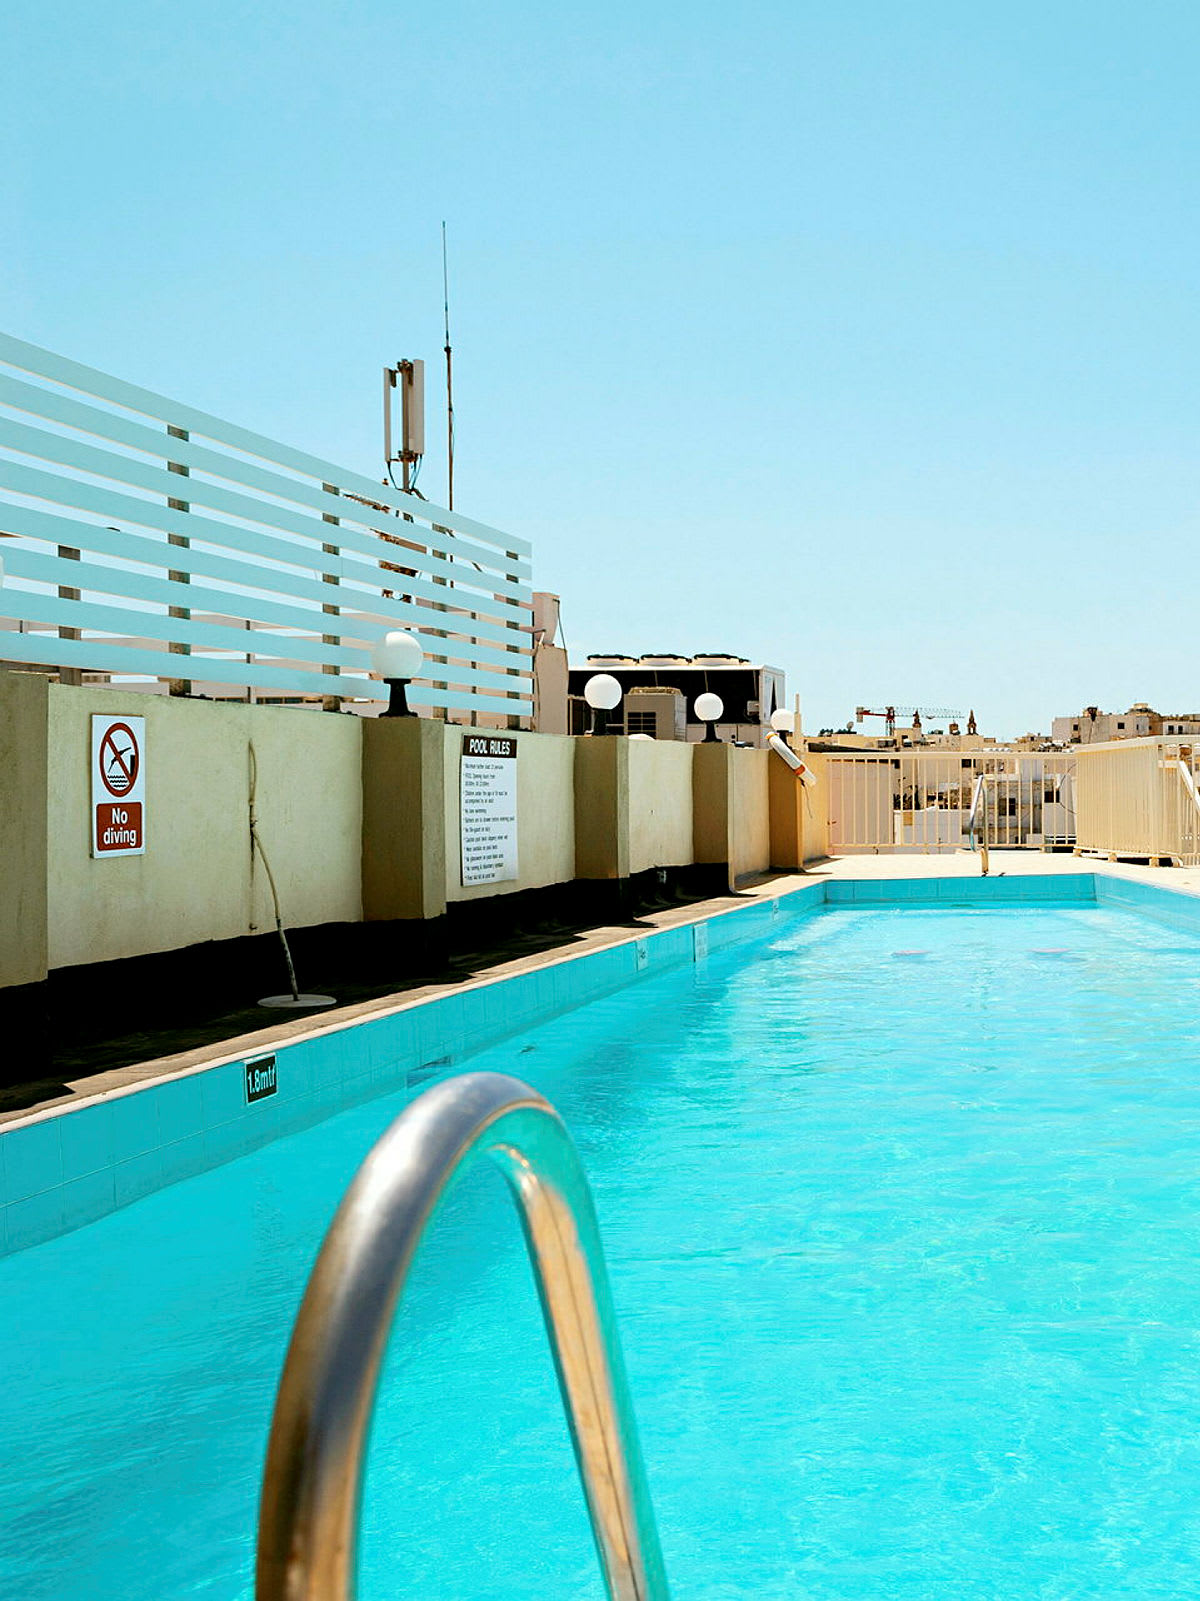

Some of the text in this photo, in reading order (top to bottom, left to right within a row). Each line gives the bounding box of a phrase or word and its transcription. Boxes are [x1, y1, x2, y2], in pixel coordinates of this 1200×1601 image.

[469, 738, 510, 755] POOL RULES
[111, 807, 129, 825] No
[103, 826, 137, 847] diving
